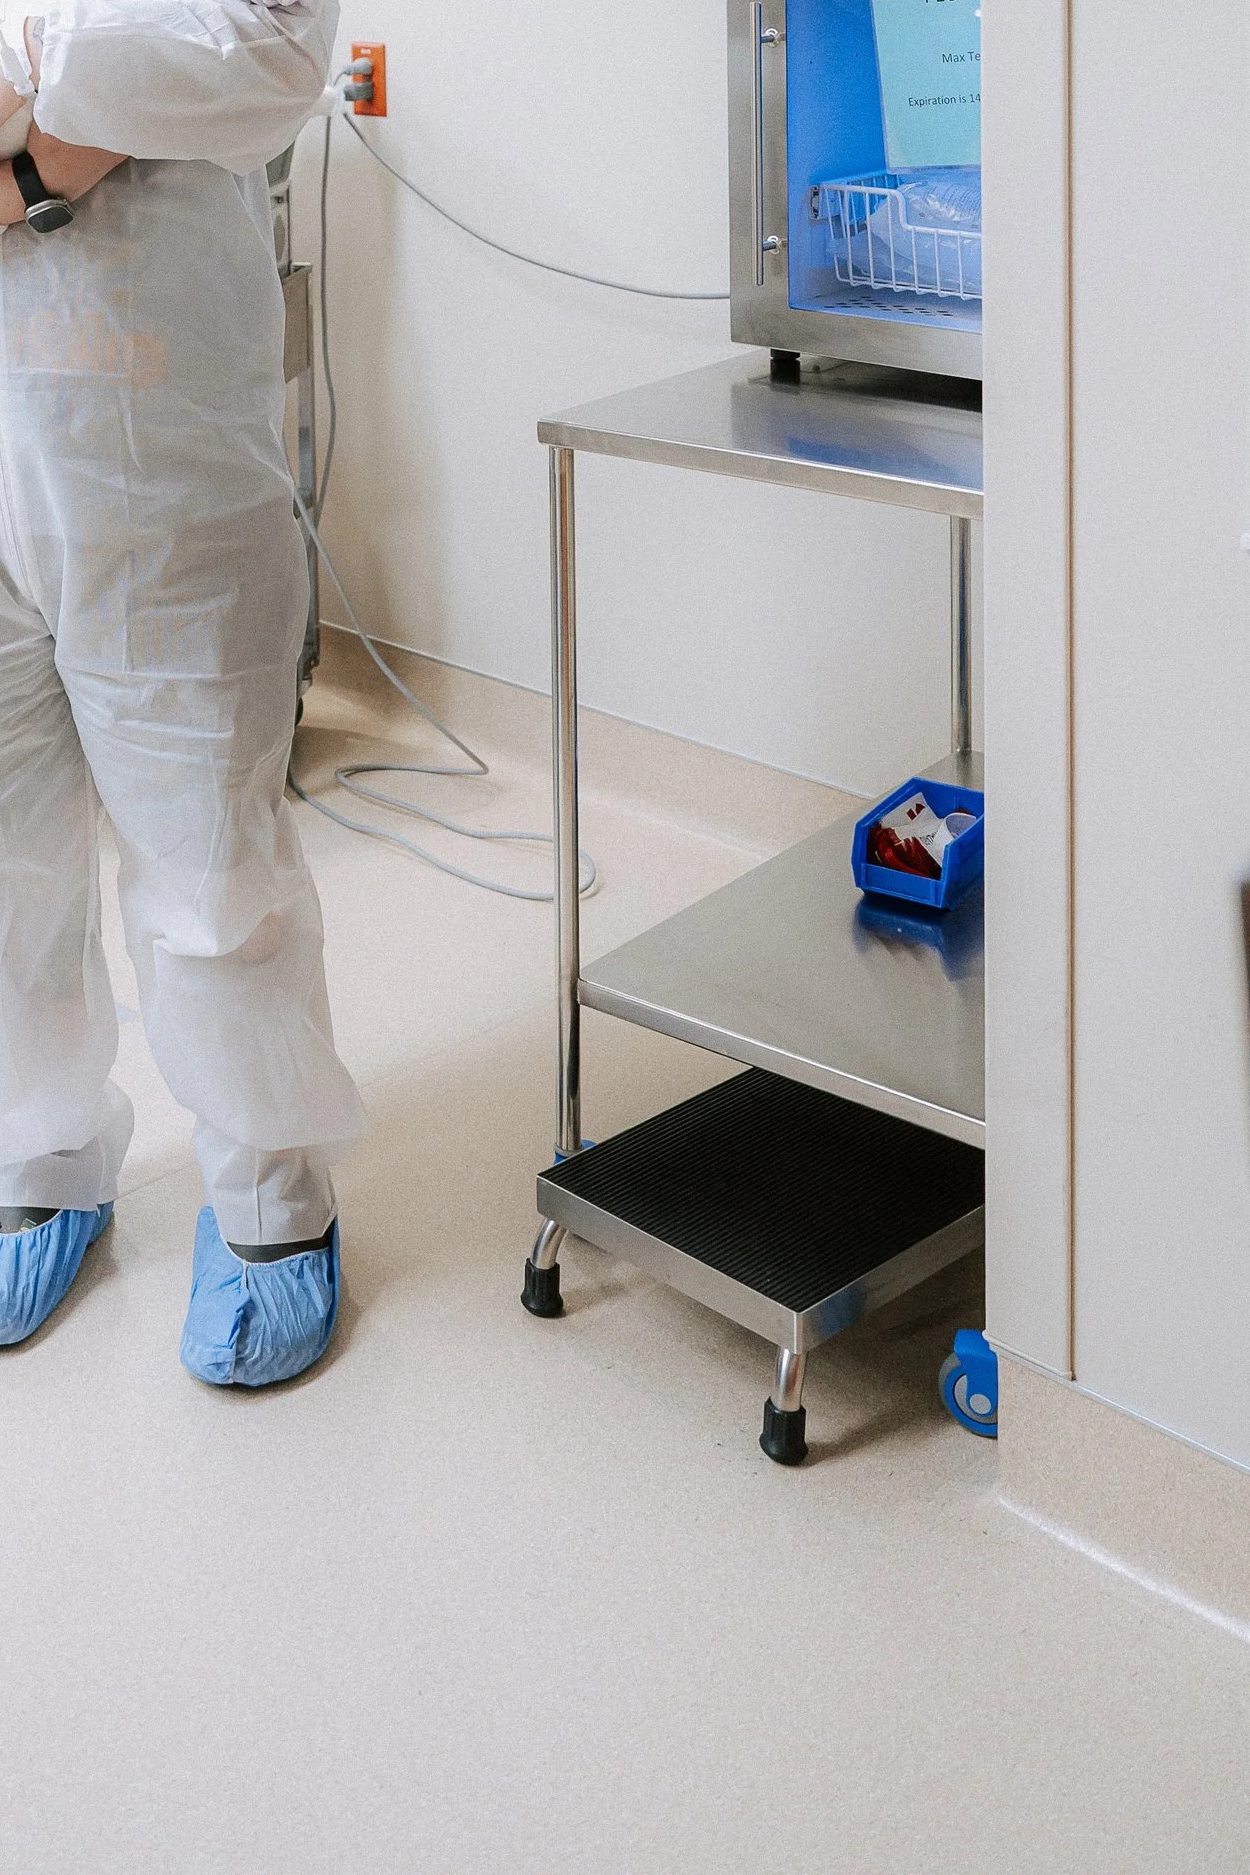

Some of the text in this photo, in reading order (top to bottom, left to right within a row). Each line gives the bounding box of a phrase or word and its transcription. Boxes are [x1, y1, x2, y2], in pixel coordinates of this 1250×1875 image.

[942, 53, 965, 63] Max
[908, 93, 981, 108] Expiration is 14
